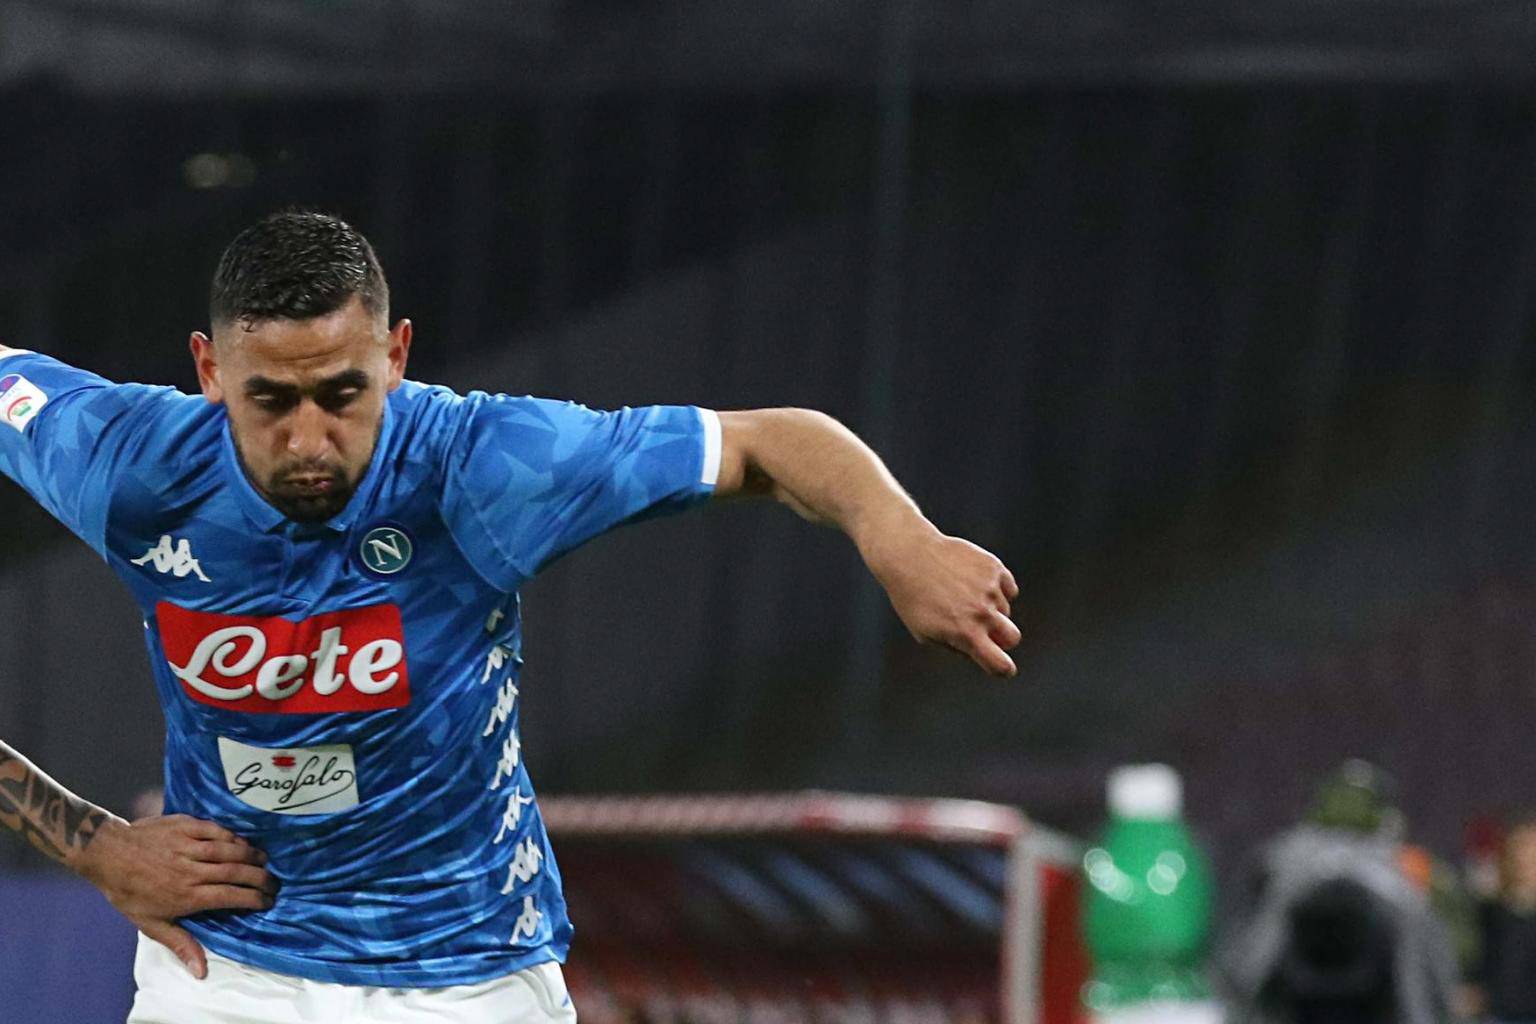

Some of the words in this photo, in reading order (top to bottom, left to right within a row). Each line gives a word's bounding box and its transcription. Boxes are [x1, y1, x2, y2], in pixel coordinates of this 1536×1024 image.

[368, 534, 403, 566] N
[168, 625, 403, 700] Lete
[231, 756, 355, 811] Garofalo
